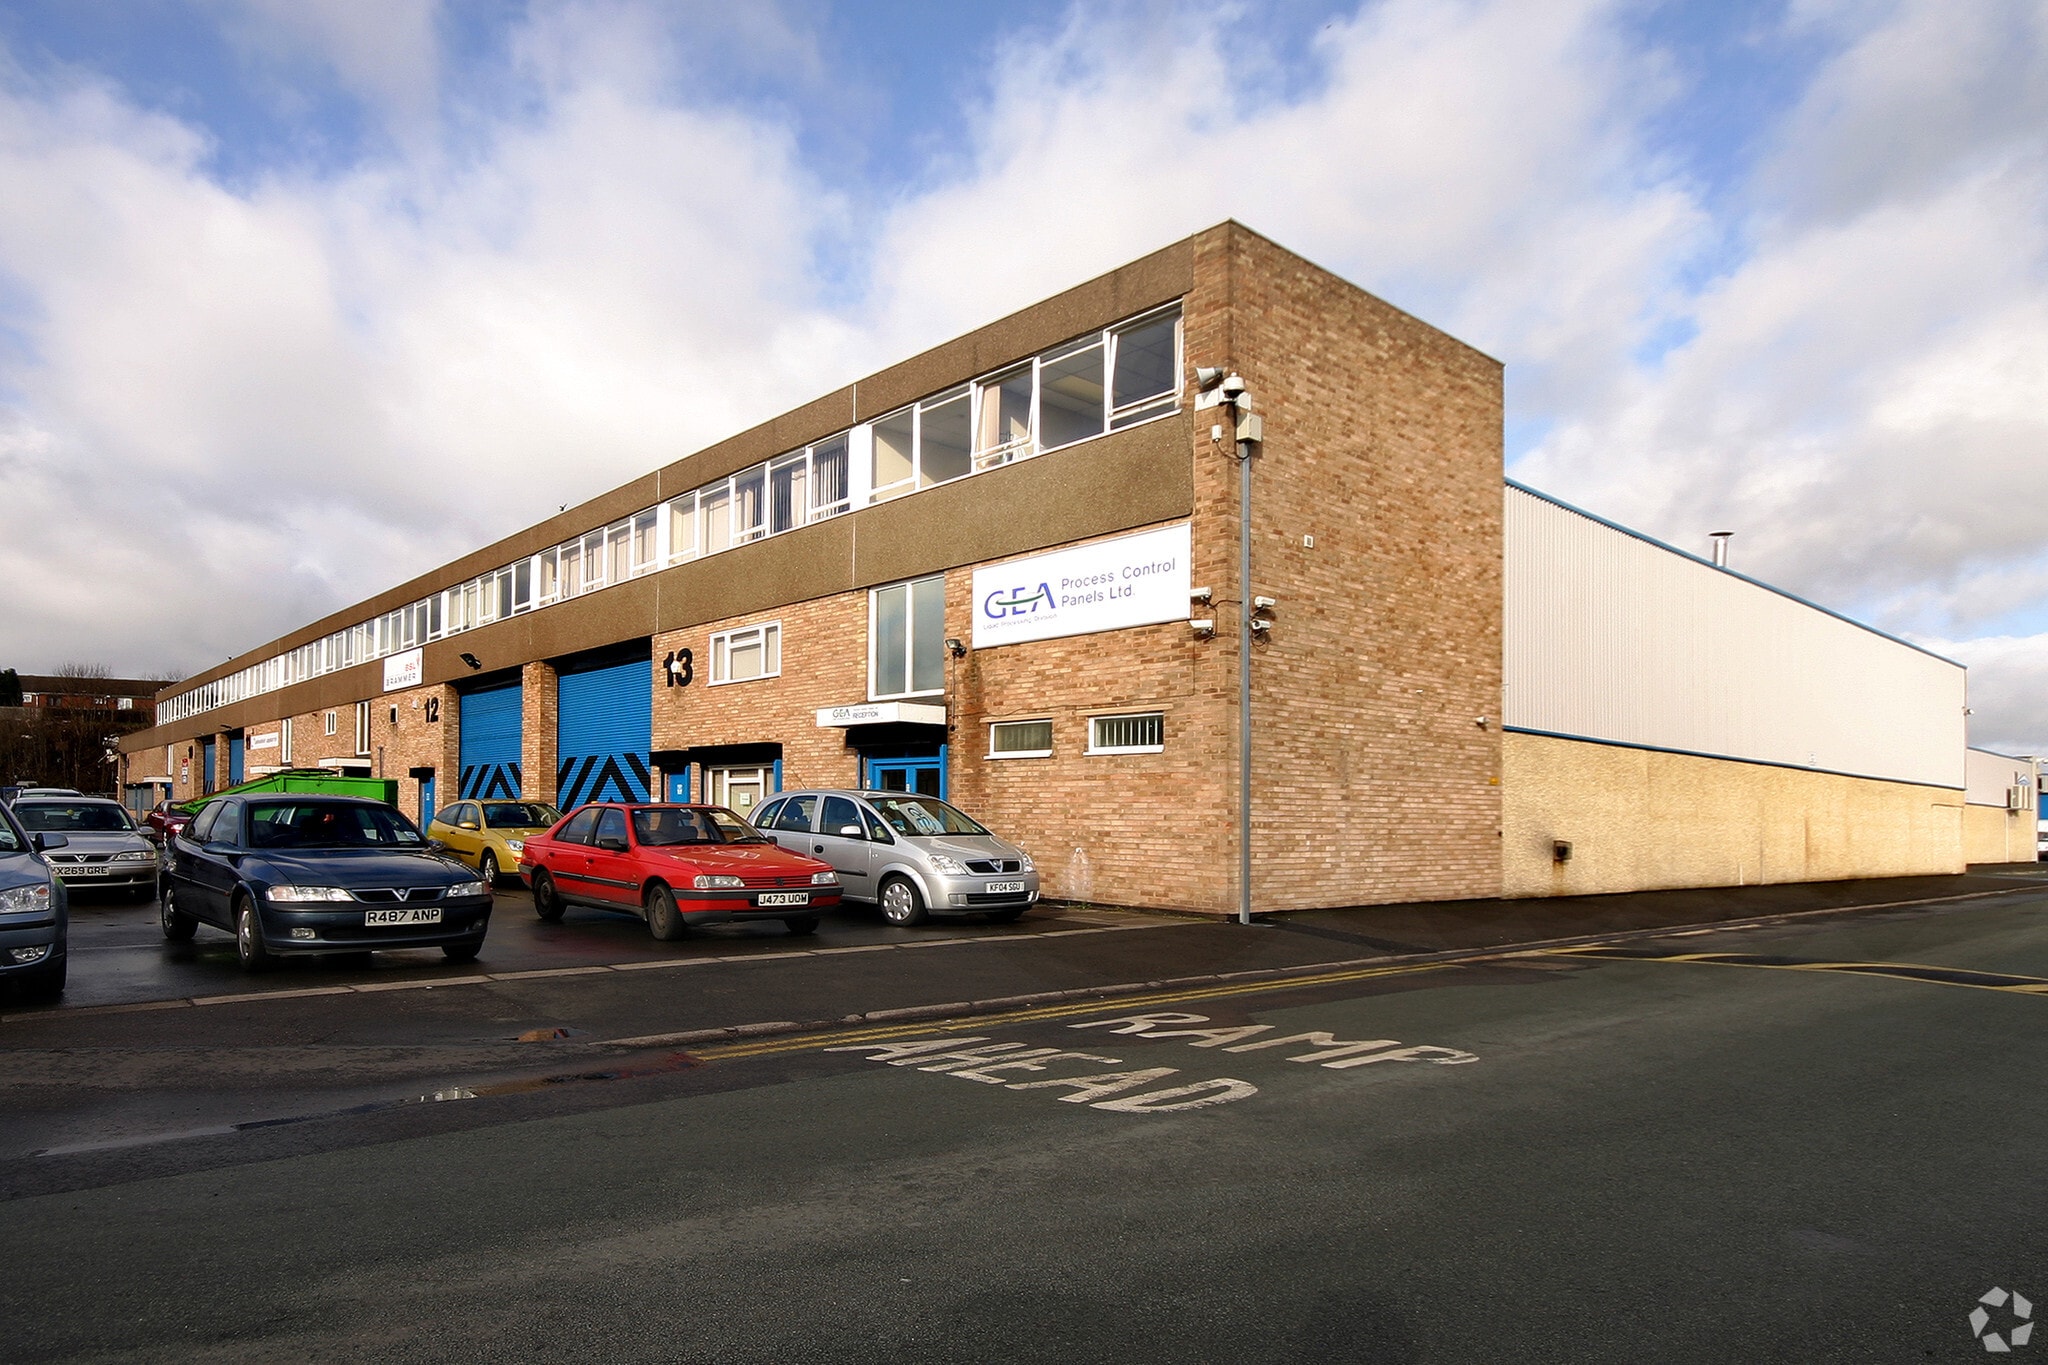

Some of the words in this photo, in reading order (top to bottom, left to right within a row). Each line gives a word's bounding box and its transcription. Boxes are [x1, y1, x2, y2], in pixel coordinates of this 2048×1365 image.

[1061, 572, 1114, 590] Process
[1122, 557, 1176, 580] Control
[984, 582, 1056, 619] GEA
[1061, 590, 1104, 607] Panels
[663, 648, 693, 687] 13
[424, 697, 439, 723] 12
[832, 708, 851, 719] GEA
[852, 711, 879, 719] RECEPTION
[87, 866, 108, 875] GRE
[760, 894, 786, 905] J473
[367, 911, 408, 923] R487
[411, 909, 440, 921] ANP
[1066, 1012, 1480, 1069] RAMP
[823, 1036, 1259, 1113] AHEAD
